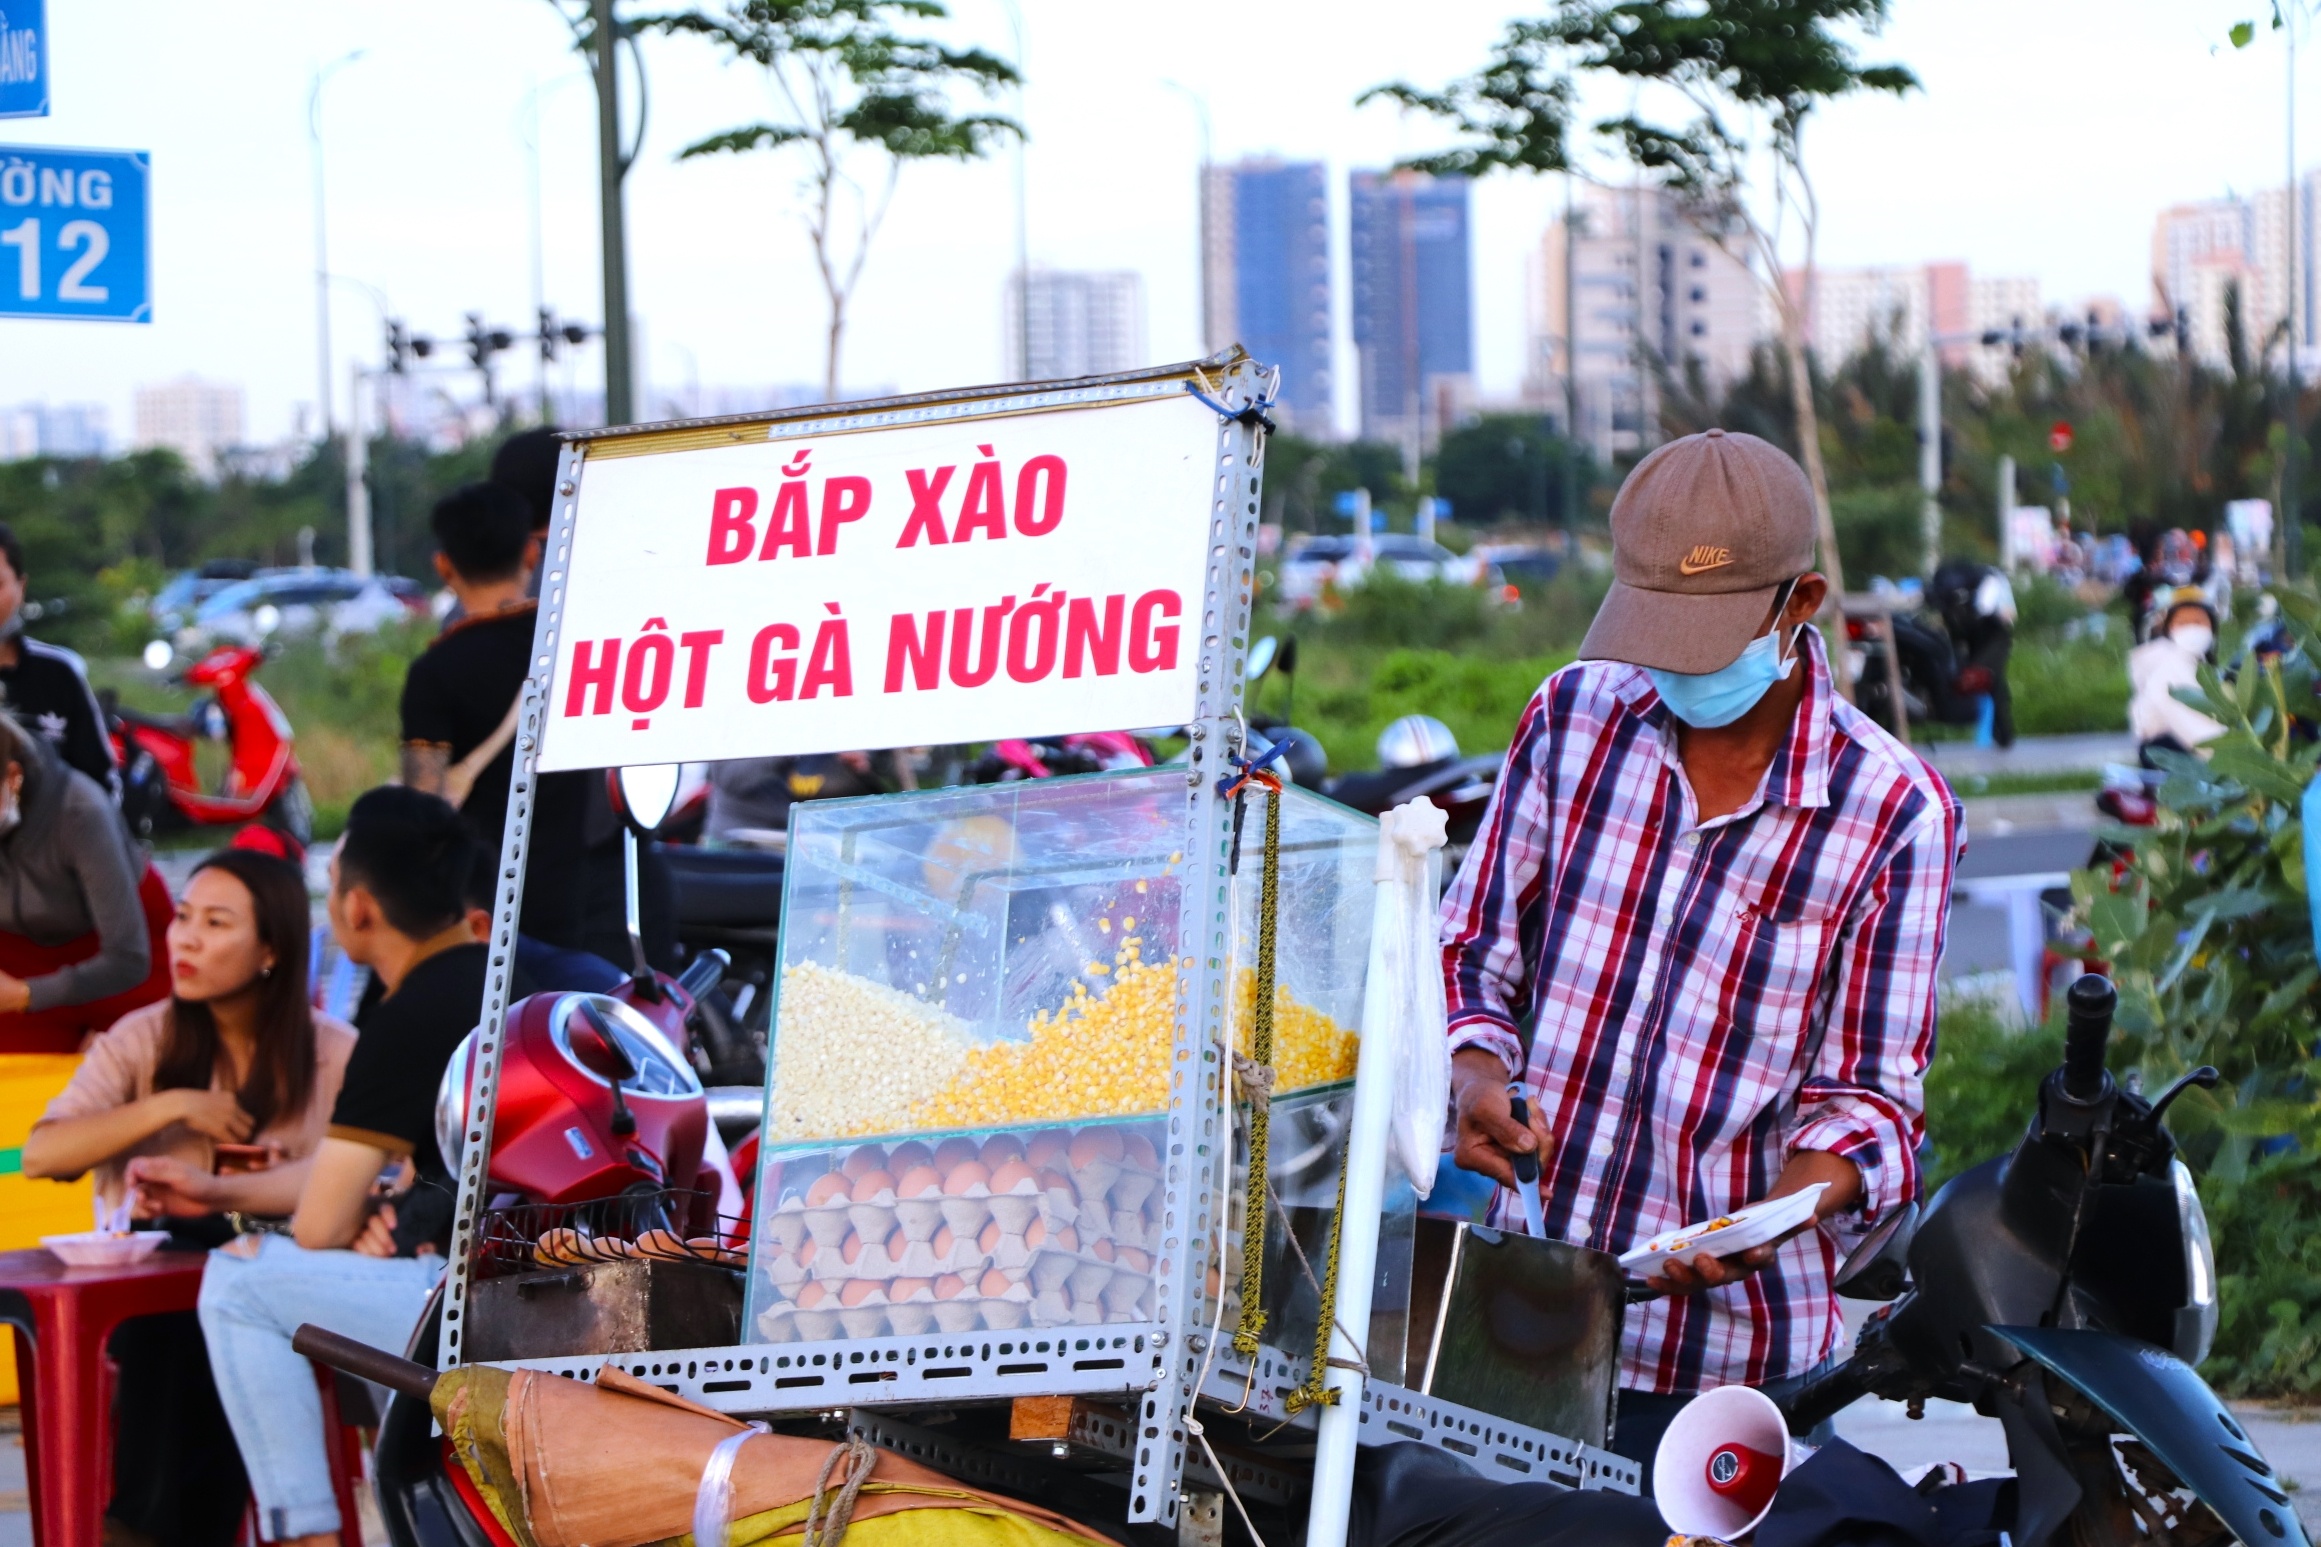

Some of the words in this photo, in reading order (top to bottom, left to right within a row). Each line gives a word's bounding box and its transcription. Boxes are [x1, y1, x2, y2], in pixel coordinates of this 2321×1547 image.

[0, 156, 113, 209] ỜNG
[1, 217, 109, 302] 12
[706, 449, 872, 566] BẮP
[896, 444, 1067, 549] XÀO
[1688, 545, 1730, 564] NIKE
[564, 617, 723, 731] HỘT
[747, 602, 853, 705] GÀ
[883, 583, 1182, 693] NƯỚNG
